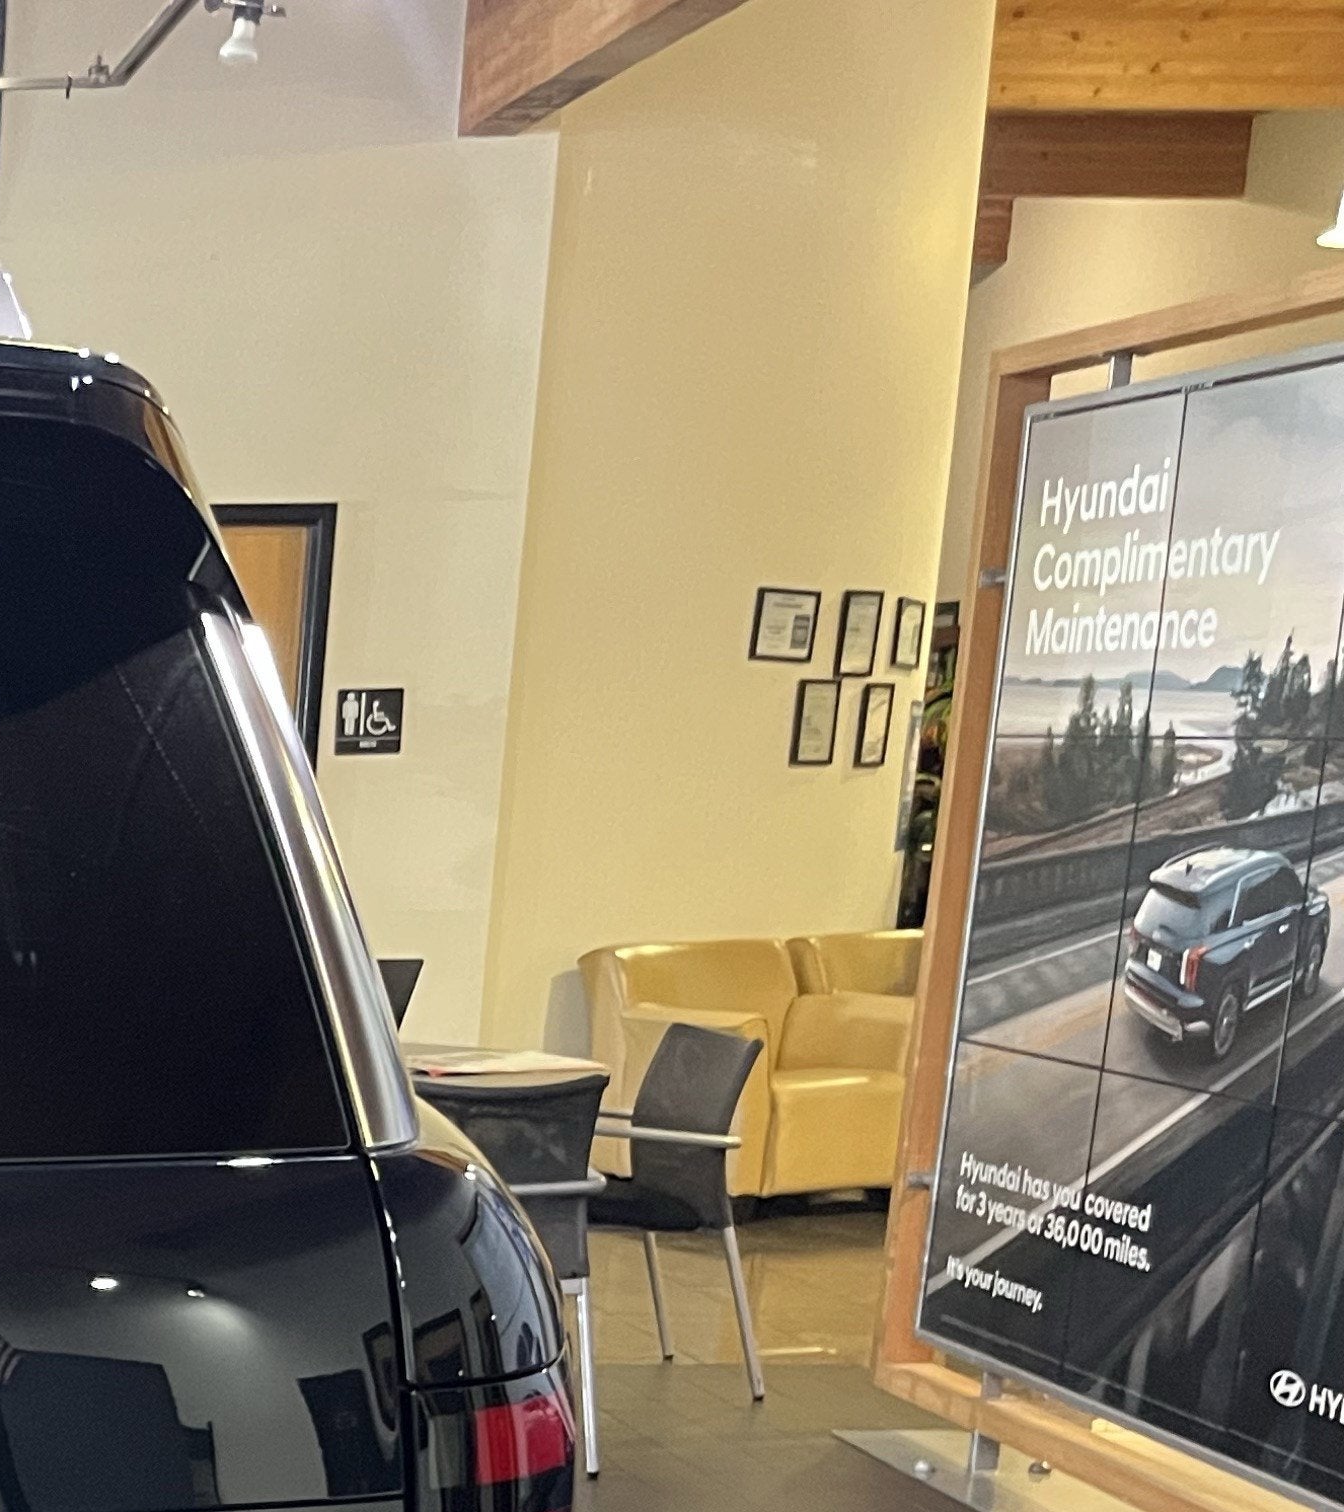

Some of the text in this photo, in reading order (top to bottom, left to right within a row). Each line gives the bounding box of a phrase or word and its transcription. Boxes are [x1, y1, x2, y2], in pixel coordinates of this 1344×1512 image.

[1040, 456, 1172, 534] Hyundai
[1033, 527, 1281, 596] Complimentary
[1025, 602, 1218, 656] Maintenance
[956, 1184, 1151, 1272] for 3 years or 36,000 miles.
[960, 1151, 1152, 1232] Hyundai has you covered
[964, 1265, 994, 1290] your
